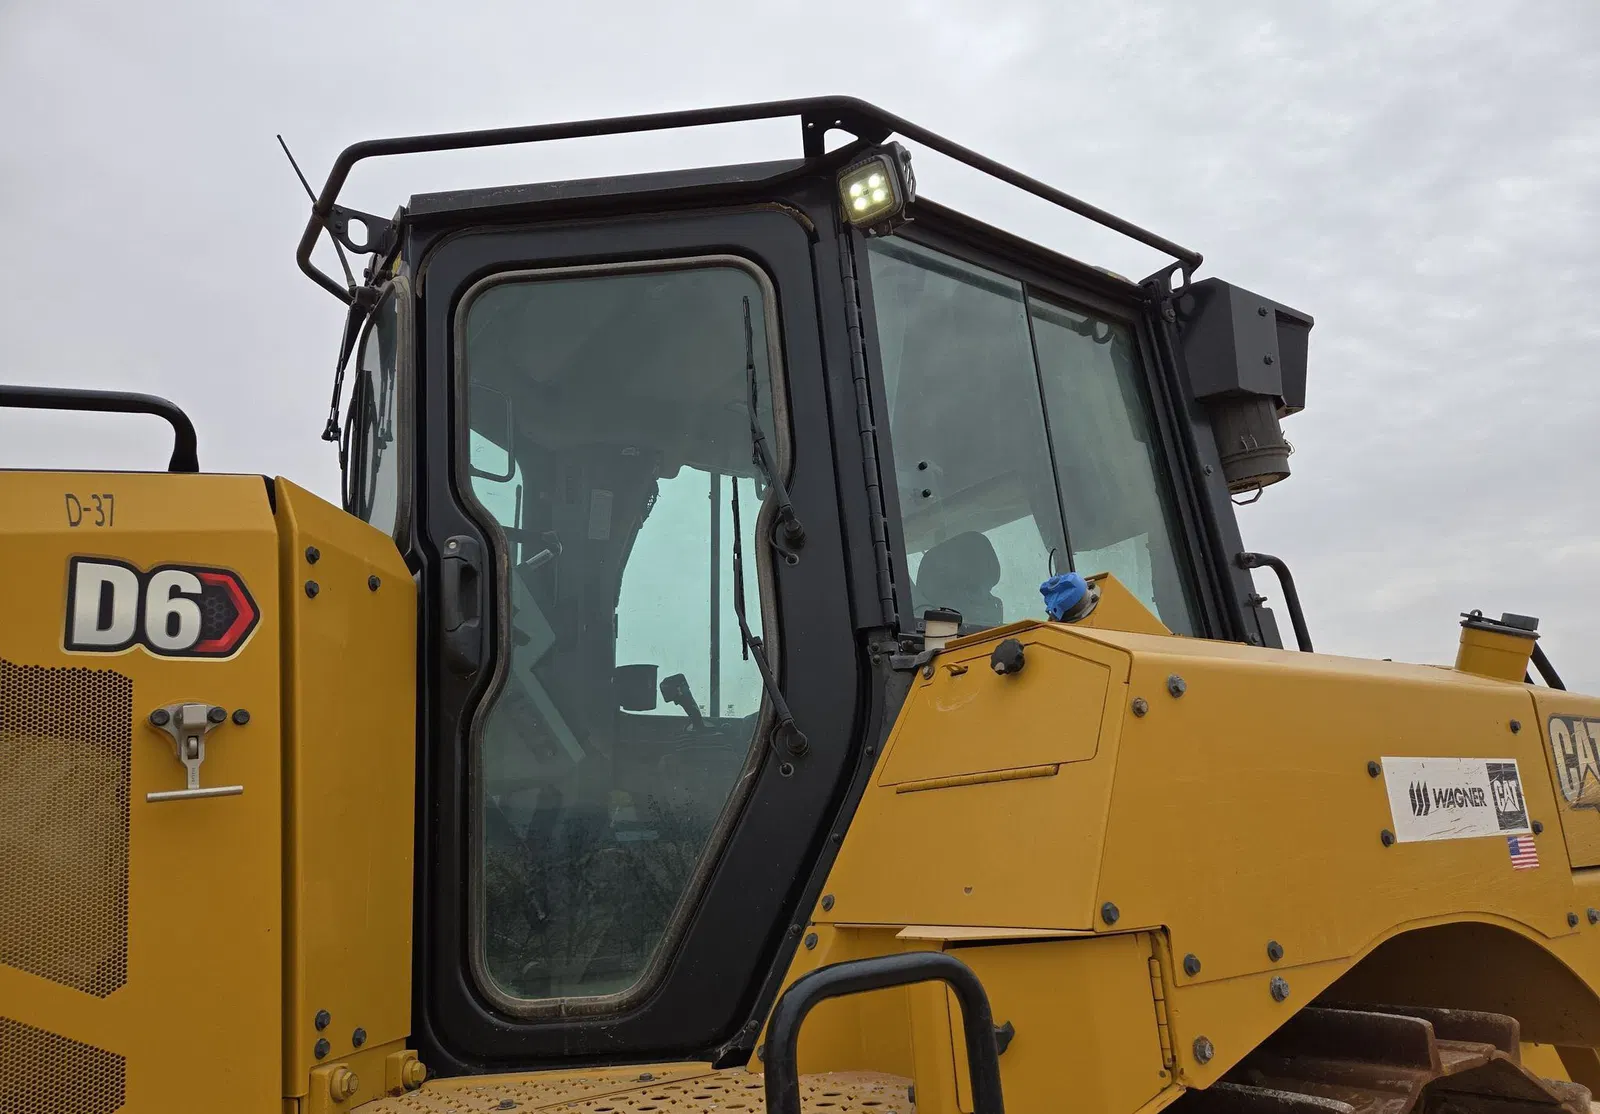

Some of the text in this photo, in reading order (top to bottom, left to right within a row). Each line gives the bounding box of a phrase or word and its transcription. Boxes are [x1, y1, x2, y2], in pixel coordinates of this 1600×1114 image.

[65, 493, 114, 527] D-37
[72, 562, 202, 650] D6
[1432, 780, 1521, 812] WAGNER CAT
